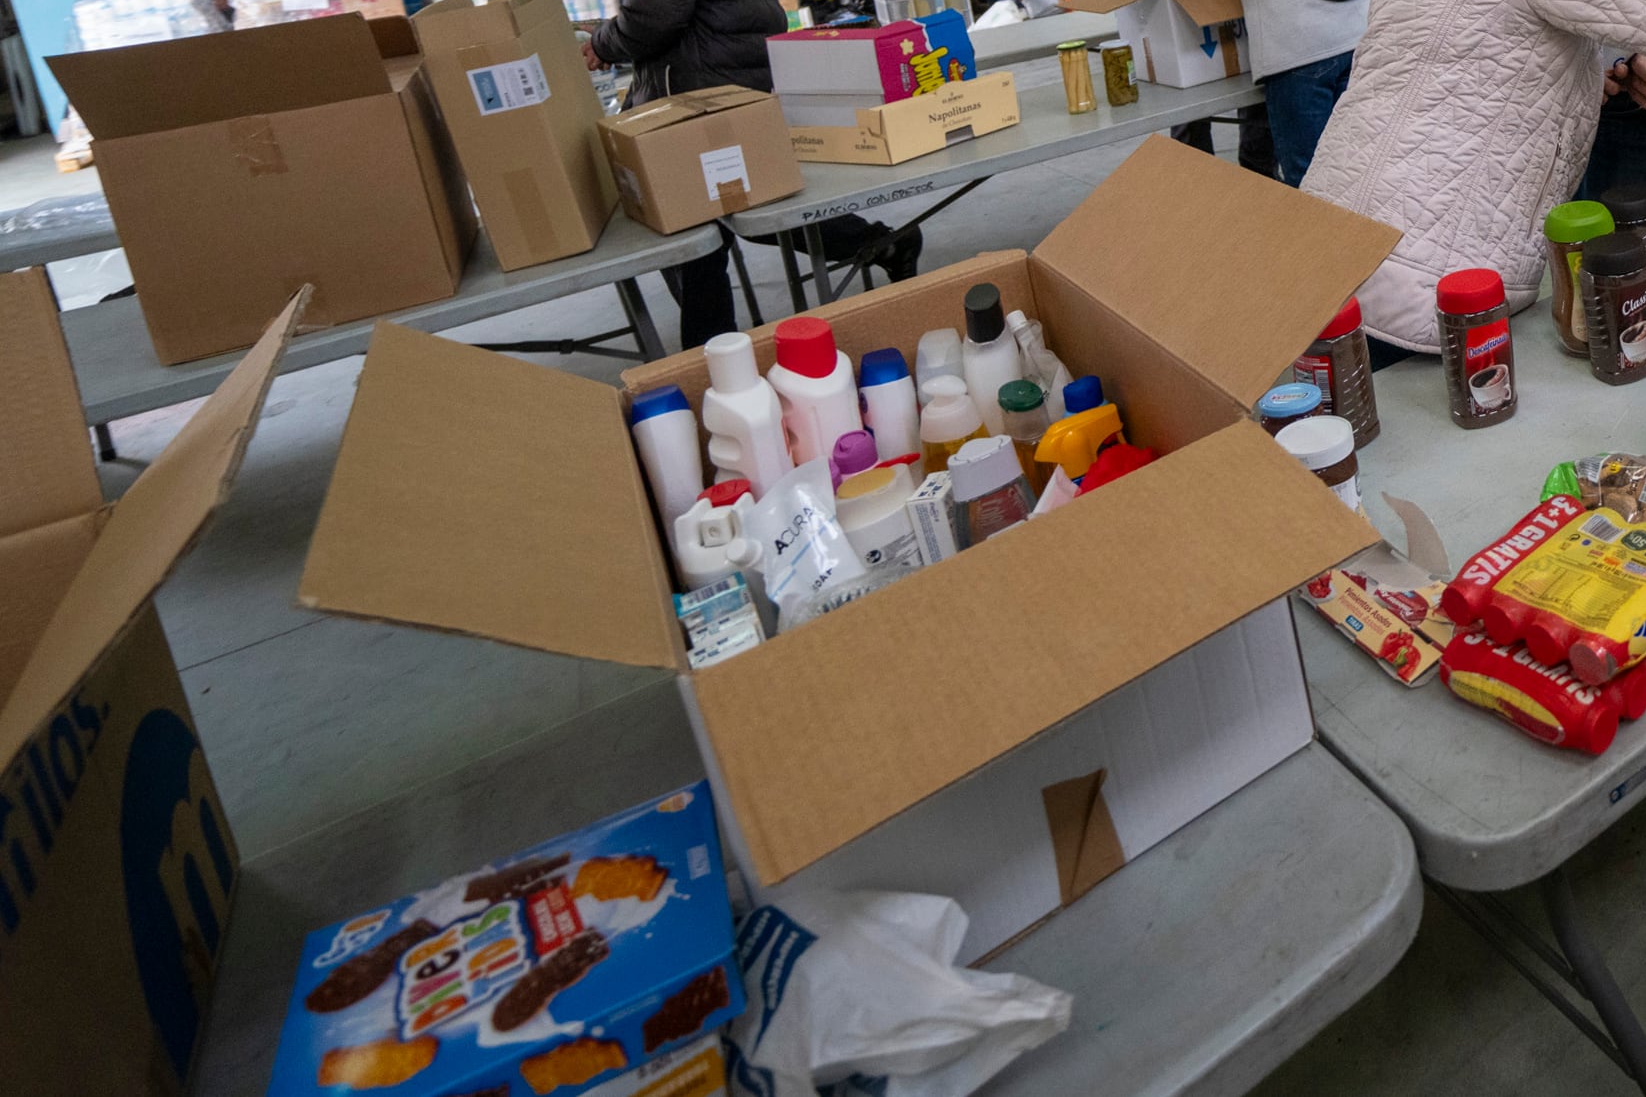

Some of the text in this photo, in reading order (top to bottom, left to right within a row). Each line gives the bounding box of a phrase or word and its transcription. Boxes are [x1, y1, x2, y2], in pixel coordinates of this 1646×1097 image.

[928, 102, 982, 123] Napolitanas
[791, 135, 824, 147] politanas
[774, 506, 816, 556] ACURA
[1463, 496, 1578, 586] 3+1 GRATIS
[1344, 587, 1393, 628] Pimientos Asados
